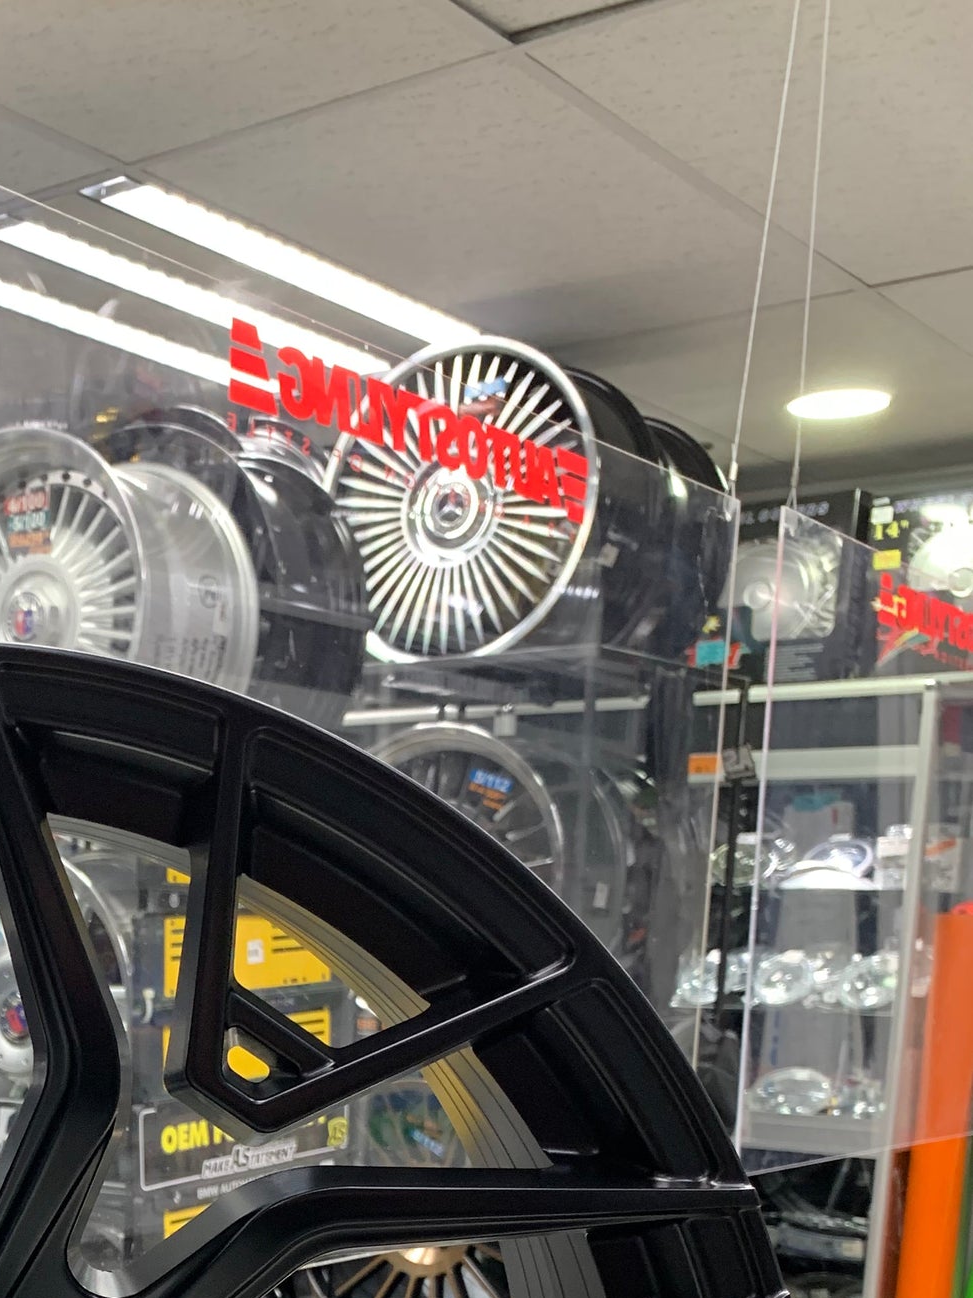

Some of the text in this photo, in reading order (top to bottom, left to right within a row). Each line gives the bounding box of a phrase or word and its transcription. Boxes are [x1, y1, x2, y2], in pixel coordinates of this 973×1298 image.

[874, 519, 910, 541] 14"
[161, 1118, 210, 1154] OEM
[197, 1184, 219, 1200] BMW
